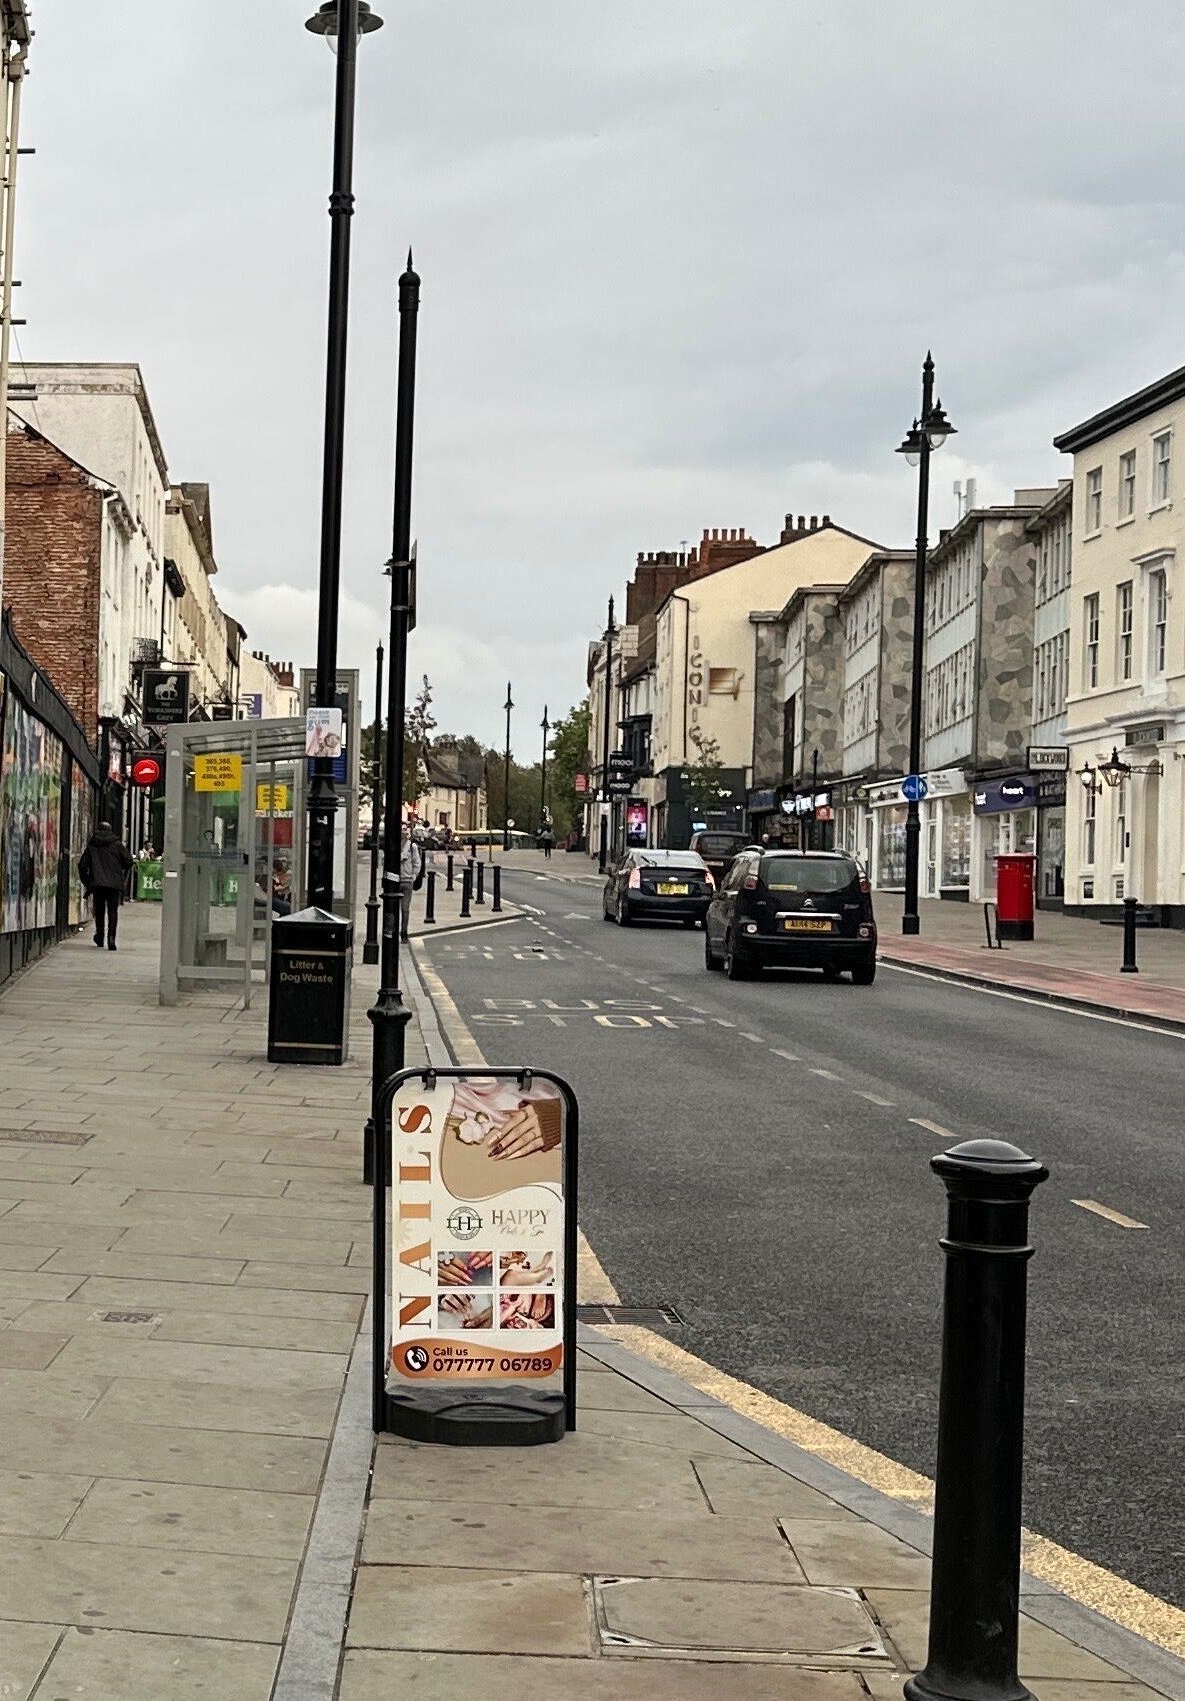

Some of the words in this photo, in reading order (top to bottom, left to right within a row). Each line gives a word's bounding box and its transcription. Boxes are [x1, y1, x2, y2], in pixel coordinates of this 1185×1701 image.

[289, 960, 316, 970] Litter
[317, 961, 325, 970] &
[279, 971, 301, 983] Dog
[301, 972, 334, 983] Waste
[481, 998, 663, 1011] BUS
[470, 1013, 707, 1029] STOP
[397, 1104, 432, 1330] NAILS
[491, 1208, 551, 1225] HAPPY
[432, 1347, 453, 1357] Call
[455, 1348, 469, 1357] us
[432, 1358, 495, 1372] 077777
[499, 1358, 553, 1372] 06789
